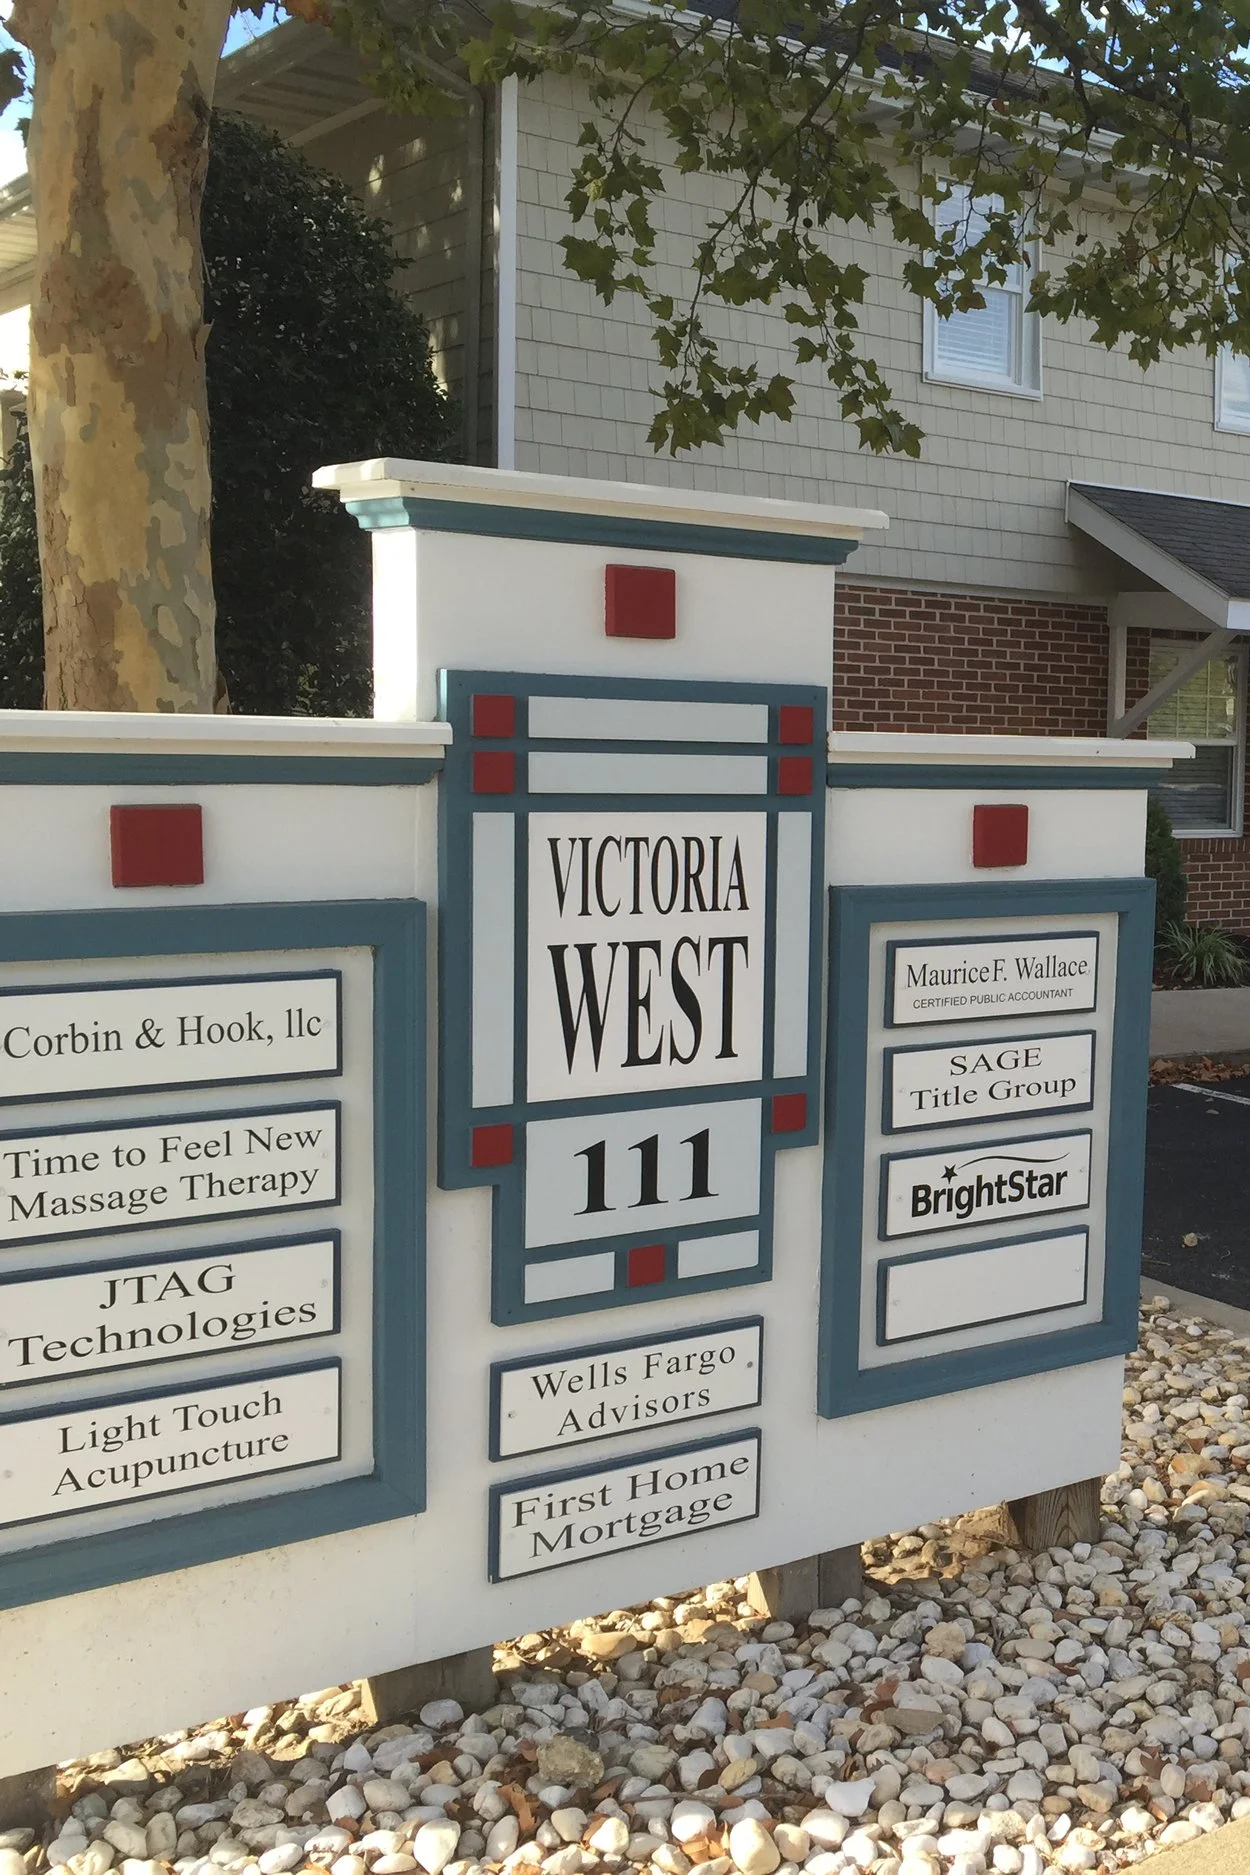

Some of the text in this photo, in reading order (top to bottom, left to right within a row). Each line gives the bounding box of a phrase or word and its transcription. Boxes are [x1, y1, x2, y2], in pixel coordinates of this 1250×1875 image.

[547, 835, 750, 918] VICTORIA
[906, 955, 1089, 988] Maurice F. Wallace
[913, 988, 1073, 1009] CERTIFIED PUBLIC ACCOUNTANT
[547, 935, 749, 1075] WEST
[2, 1008, 322, 1059] Corbin & Hook, llc
[950, 1047, 1042, 1076] SAGE
[910, 1076, 1077, 1110] Title Group
[3, 1126, 323, 1180] Time to Feel New
[573, 1127, 720, 1216] 111
[7, 1168, 320, 1222] Massage Therapy
[911, 1168, 1068, 1219] BrightStar
[99, 1263, 236, 1309] JTAG
[8, 1301, 317, 1367] Technologies
[530, 1345, 736, 1400] Wells Fargo
[58, 1390, 283, 1454] Light Touch
[556, 1387, 710, 1437] Advisors
[51, 1433, 289, 1496] Acupuncture
[511, 1456, 750, 1528] First Home
[529, 1492, 733, 1559] Mortgage
